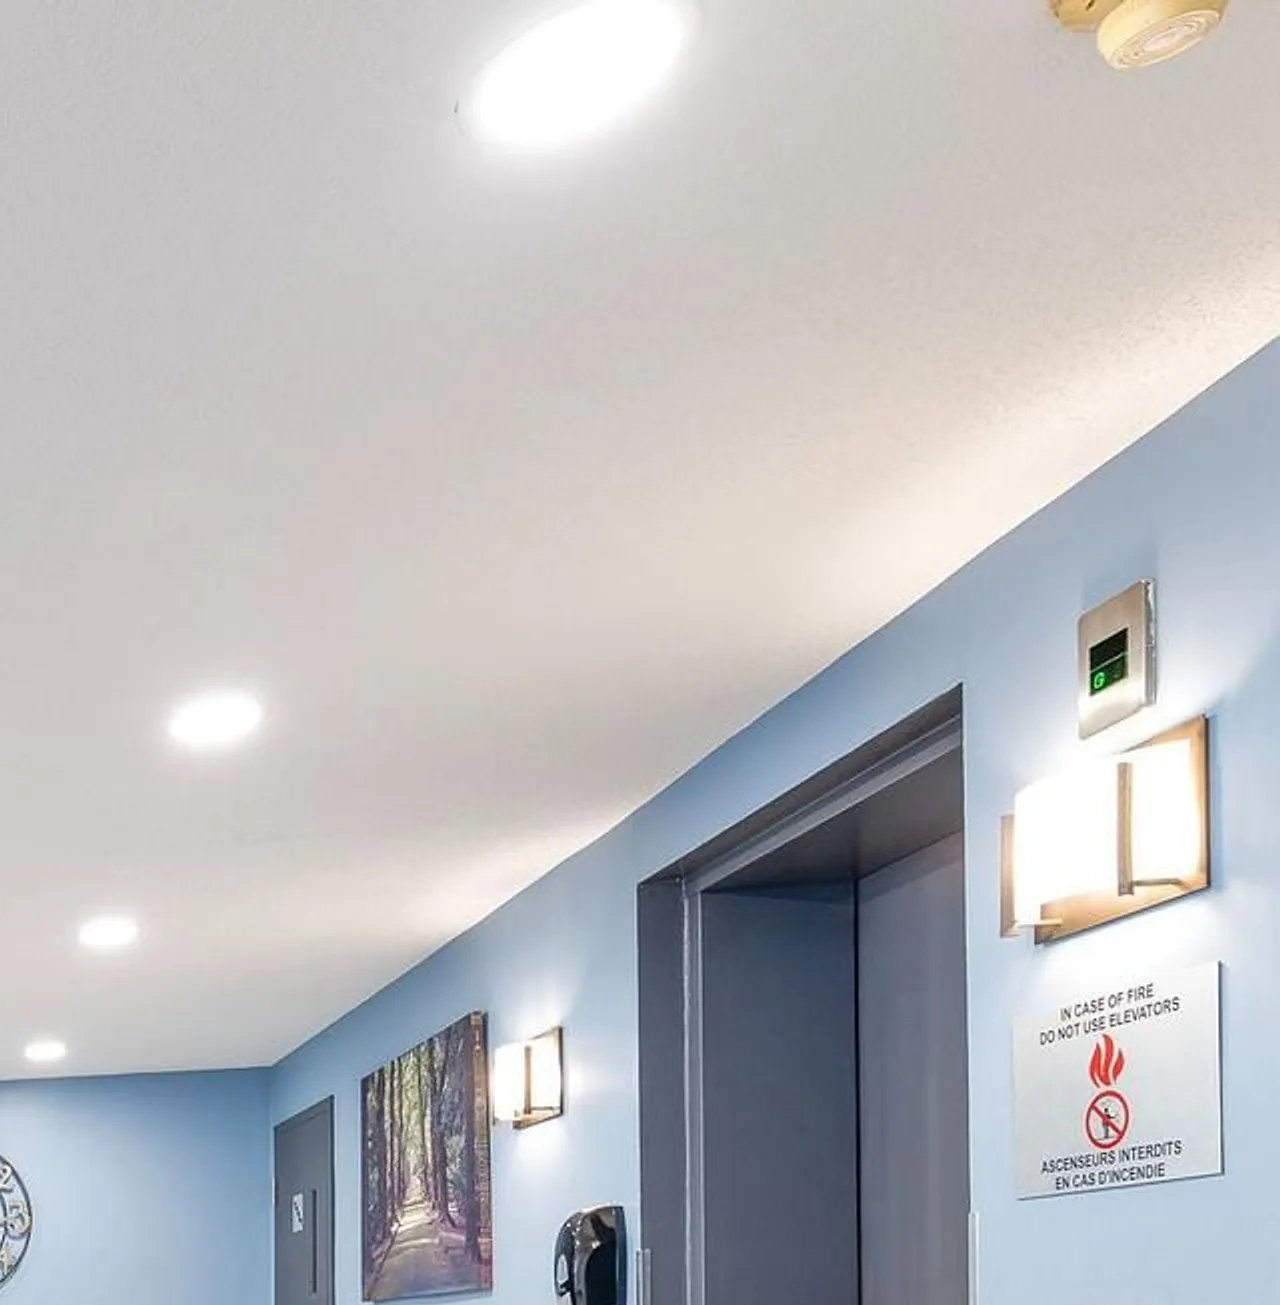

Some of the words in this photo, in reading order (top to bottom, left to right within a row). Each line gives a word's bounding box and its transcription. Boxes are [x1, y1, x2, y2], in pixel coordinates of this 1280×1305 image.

[1093, 671, 1105, 689] G
[1060, 1006, 1072, 1021] IN
[1074, 997, 1105, 1018] CASE
[1108, 992, 1124, 1009] OF
[1127, 983, 1154, 1002] FIRE
[1040, 1030, 1055, 1046] DO
[1058, 1022, 1081, 1041] NOT
[1084, 1014, 1106, 1034] USE
[1109, 996, 1181, 1028] ELEVATORS
[1041, 1151, 1116, 1174] ASCENSEURS
[1118, 1140, 1182, 1164] INTERDITS
[1056, 1176, 1070, 1190] EN
[1072, 1171, 1096, 1188] CAS
[1098, 1162, 1166, 1186] D'INCENDIE
